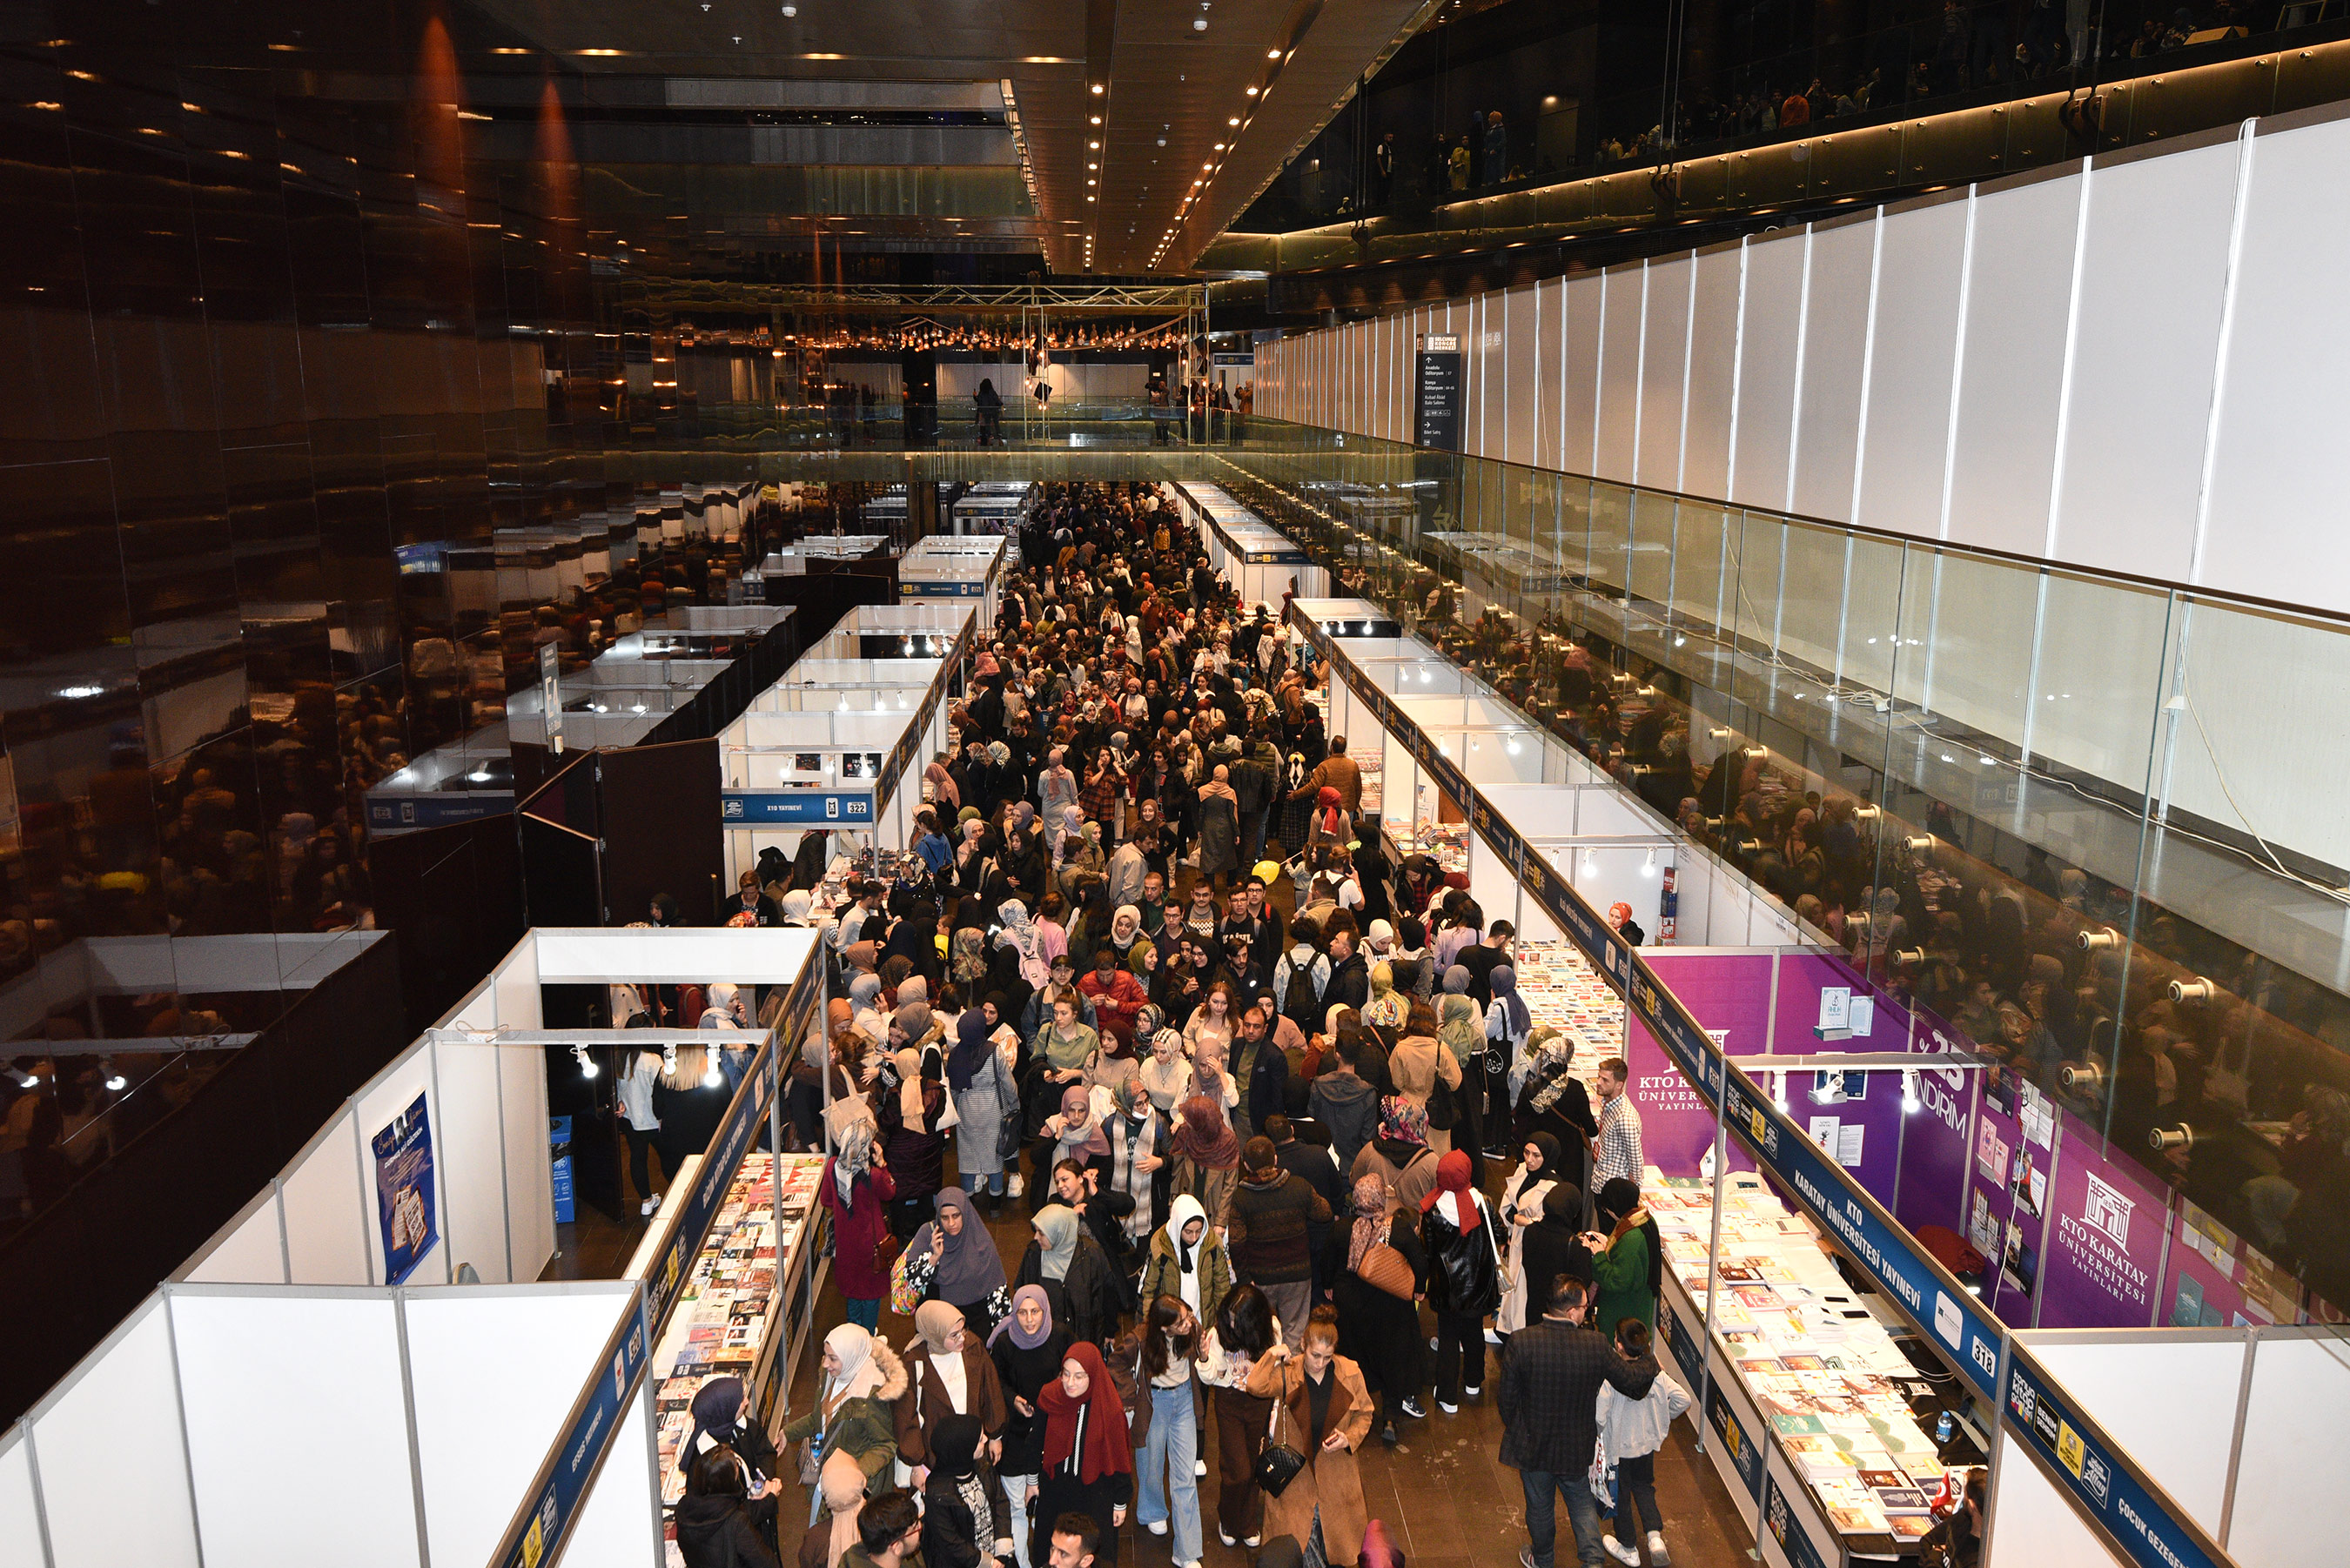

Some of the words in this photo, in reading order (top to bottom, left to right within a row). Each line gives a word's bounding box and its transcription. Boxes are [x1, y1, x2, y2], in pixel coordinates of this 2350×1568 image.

[849, 805, 865, 814] 322
[1639, 1076, 1674, 1088] KTO
[1639, 1090, 1702, 1101] ÜNİVER
[1914, 1069, 1966, 1140] NDİRİM
[1846, 1199, 1863, 1226] KTO
[1795, 1169, 1826, 1211] KARATAY
[1827, 1199, 1881, 1270] ÜNİVERSİTESİ
[1882, 1257, 1921, 1312] YAYINEVİ
[2060, 1213, 2087, 1242] KTO
[2089, 1234, 2149, 1287] KARATAY
[2058, 1230, 2145, 1305] ÜNİVERSİTESİ
[2071, 1256, 2124, 1302] YAYINLARI
[1974, 1344, 1992, 1373] 318
[2011, 1379, 2034, 1411] kitap
[2013, 1368, 2035, 1401] konya
[2118, 1498, 2147, 1537] ÇOCUK
